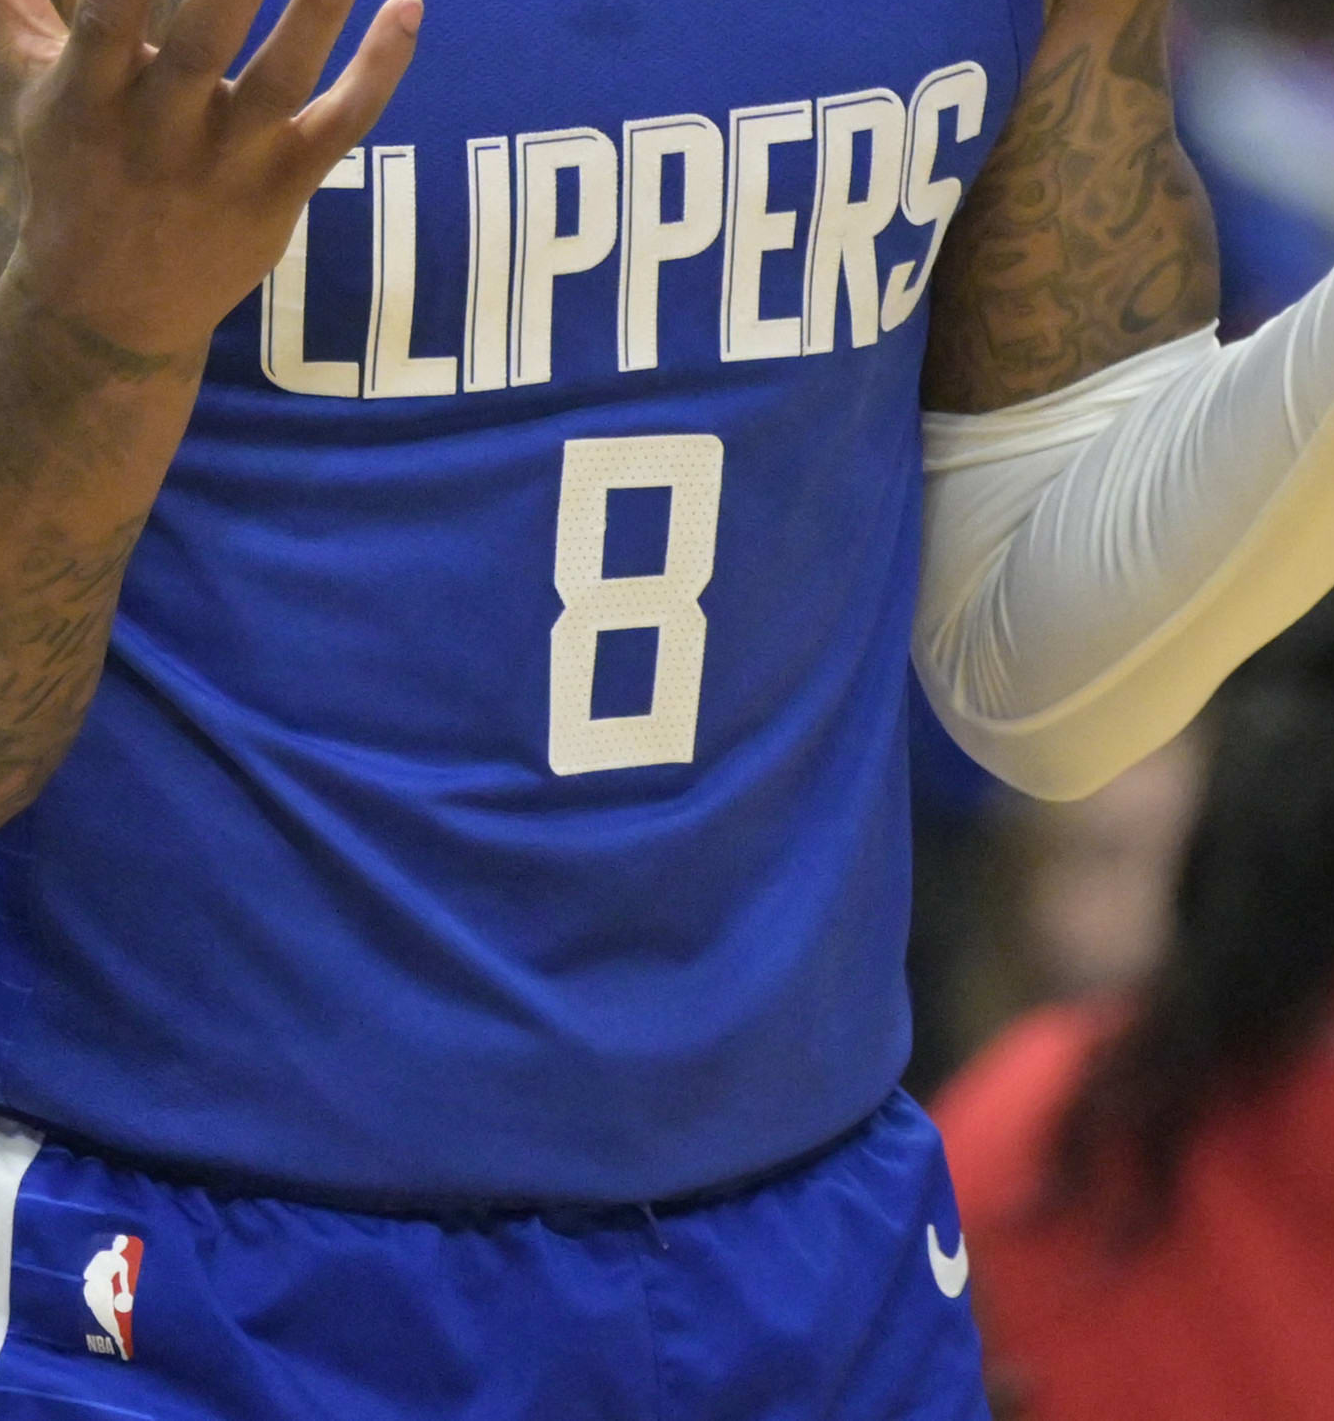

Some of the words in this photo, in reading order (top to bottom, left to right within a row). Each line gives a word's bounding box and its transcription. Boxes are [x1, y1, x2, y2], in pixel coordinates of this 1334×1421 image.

[260, 60, 988, 400] CLIPPERS
[548, 434, 724, 777] 8
[85, 1333, 116, 1356] NBA
